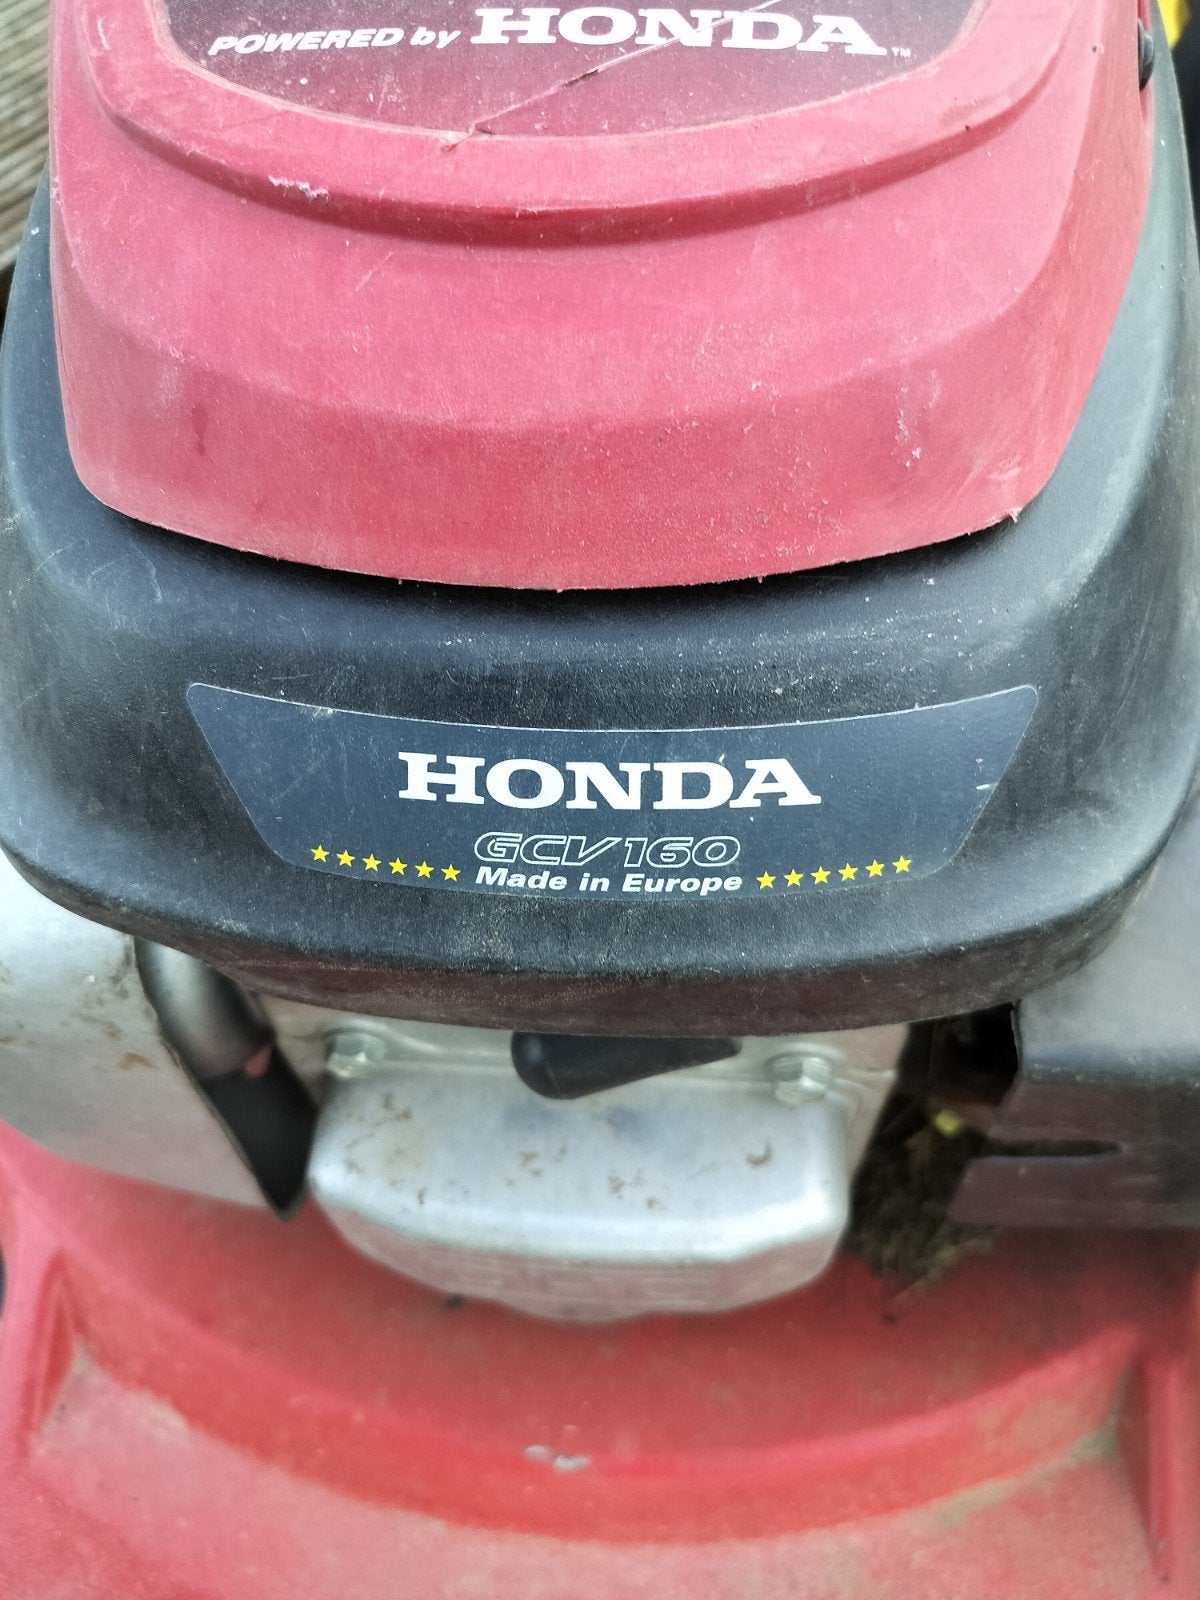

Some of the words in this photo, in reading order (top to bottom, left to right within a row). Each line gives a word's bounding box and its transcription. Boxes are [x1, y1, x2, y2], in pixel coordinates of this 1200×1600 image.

[208, 28, 404, 56] POWERED
[410, 27, 461, 49] by
[470, 8, 887, 55] HONDA
[398, 751, 821, 810] HONDA
[475, 866, 568, 891] Made
[578, 872, 610, 892] in
[621, 873, 743, 896] Europe
